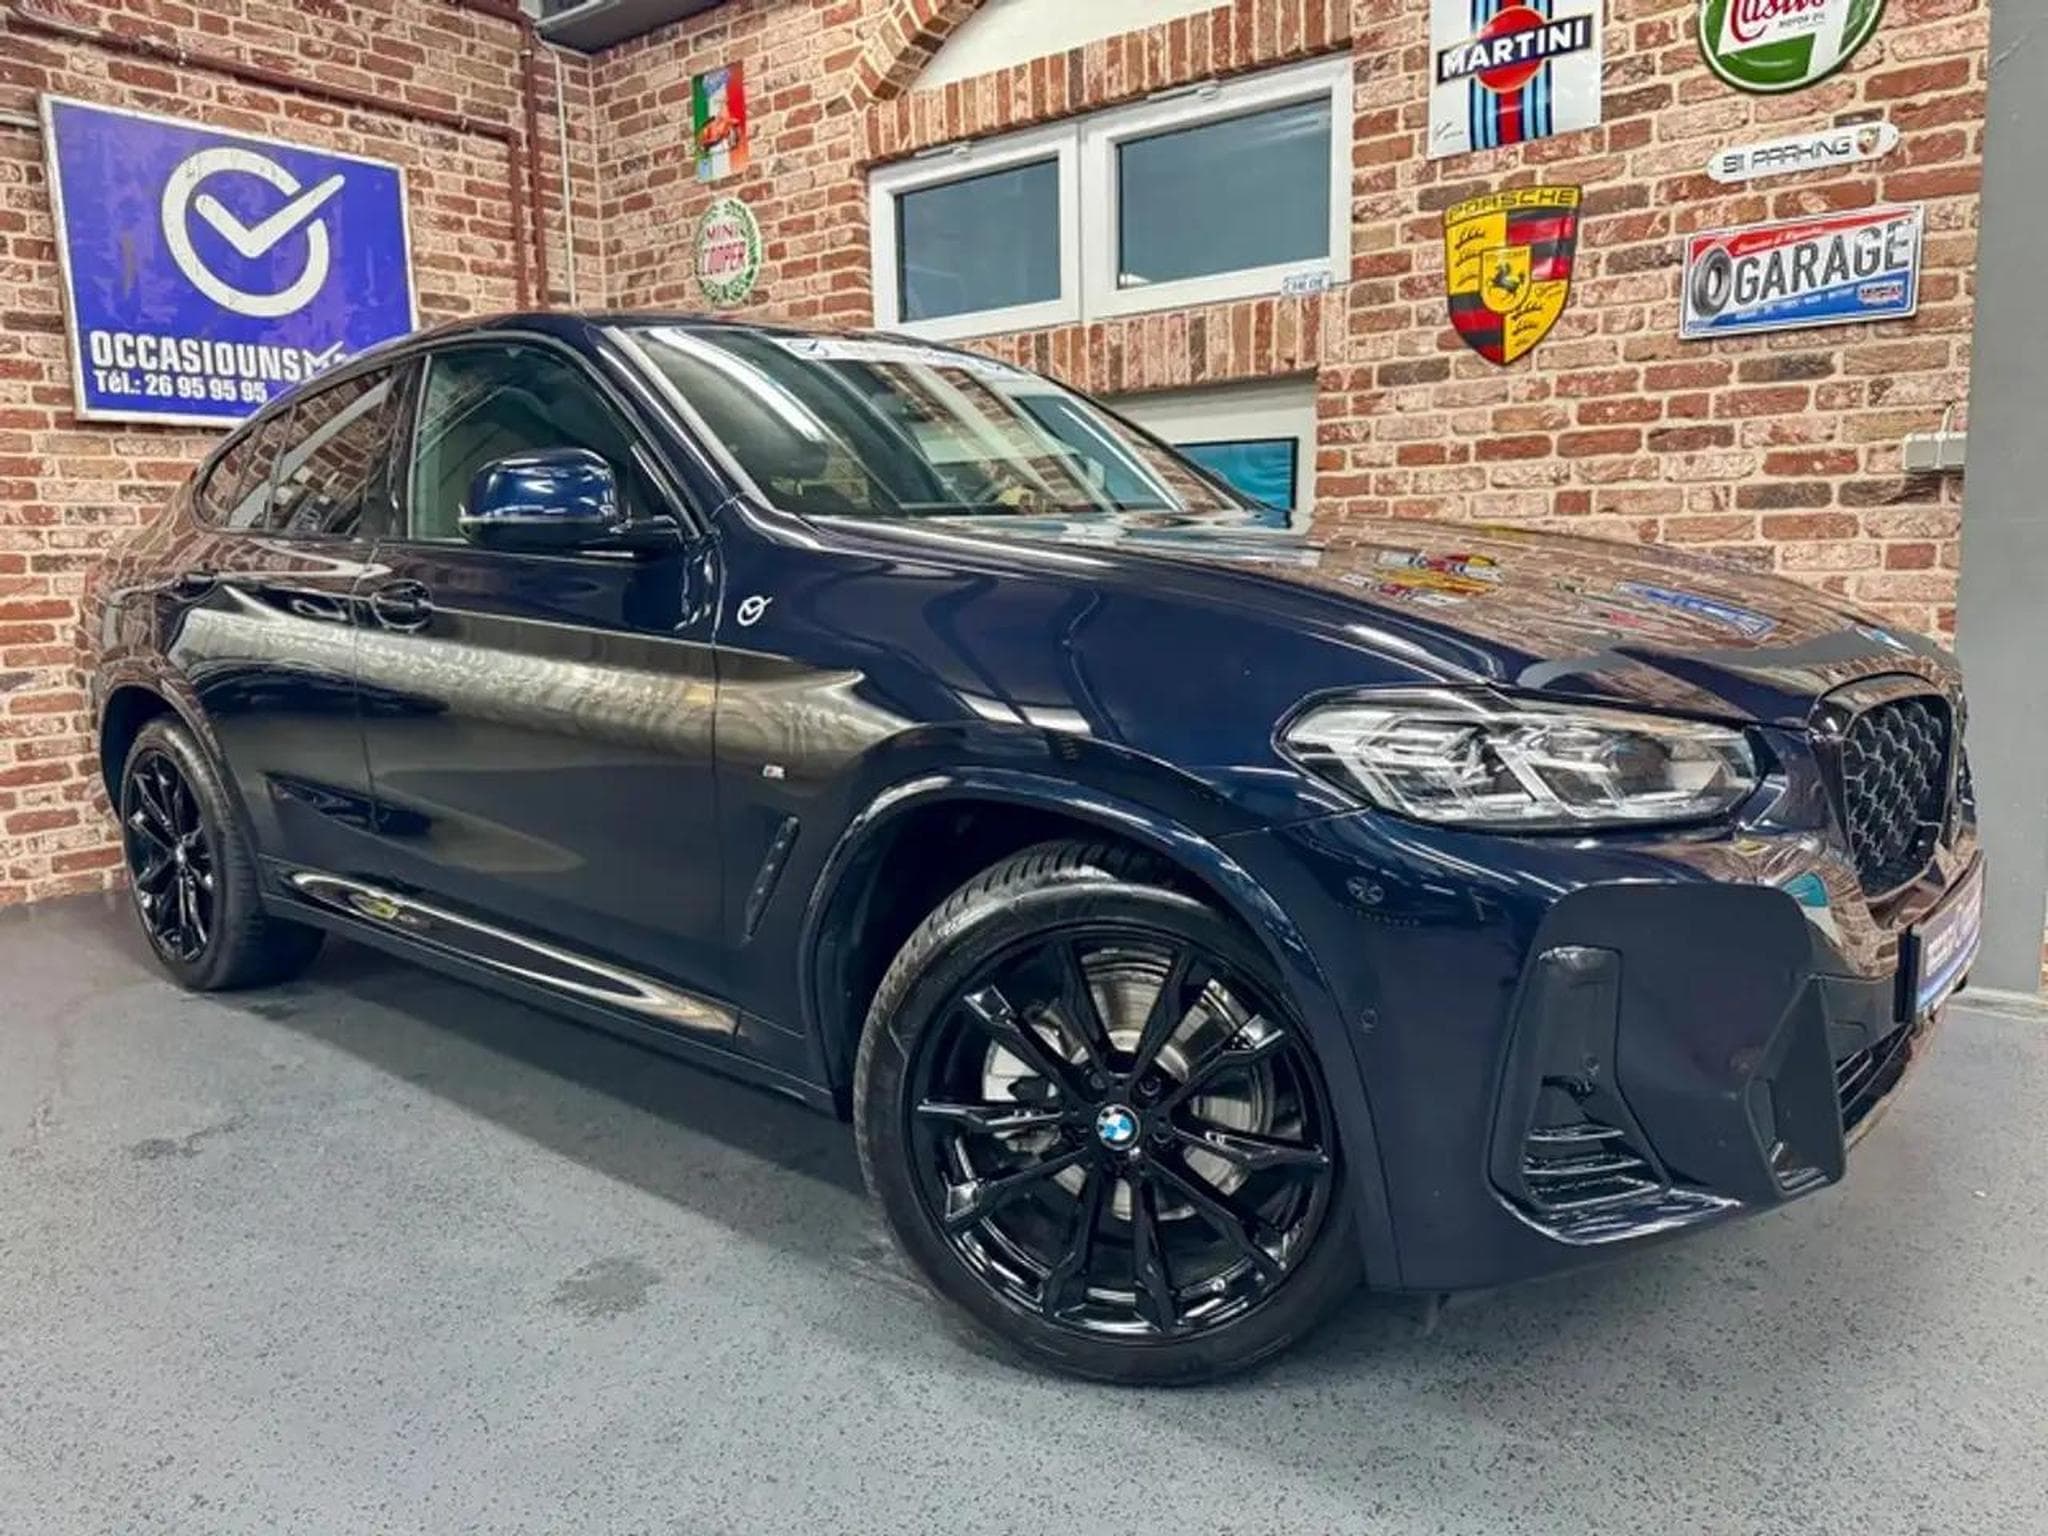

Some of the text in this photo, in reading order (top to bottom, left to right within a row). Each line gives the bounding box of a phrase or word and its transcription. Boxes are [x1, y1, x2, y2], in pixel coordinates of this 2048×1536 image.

[1442, 20, 1584, 78] MARTINI
[1751, 135, 1851, 169] PARKING
[1448, 189, 1576, 222] PORSCHE
[1734, 218, 1912, 305] GARAGE
[145, 373, 173, 397] 26
[177, 375, 203, 400] 95
[209, 378, 237, 402] 95
[241, 380, 268, 404] 95
